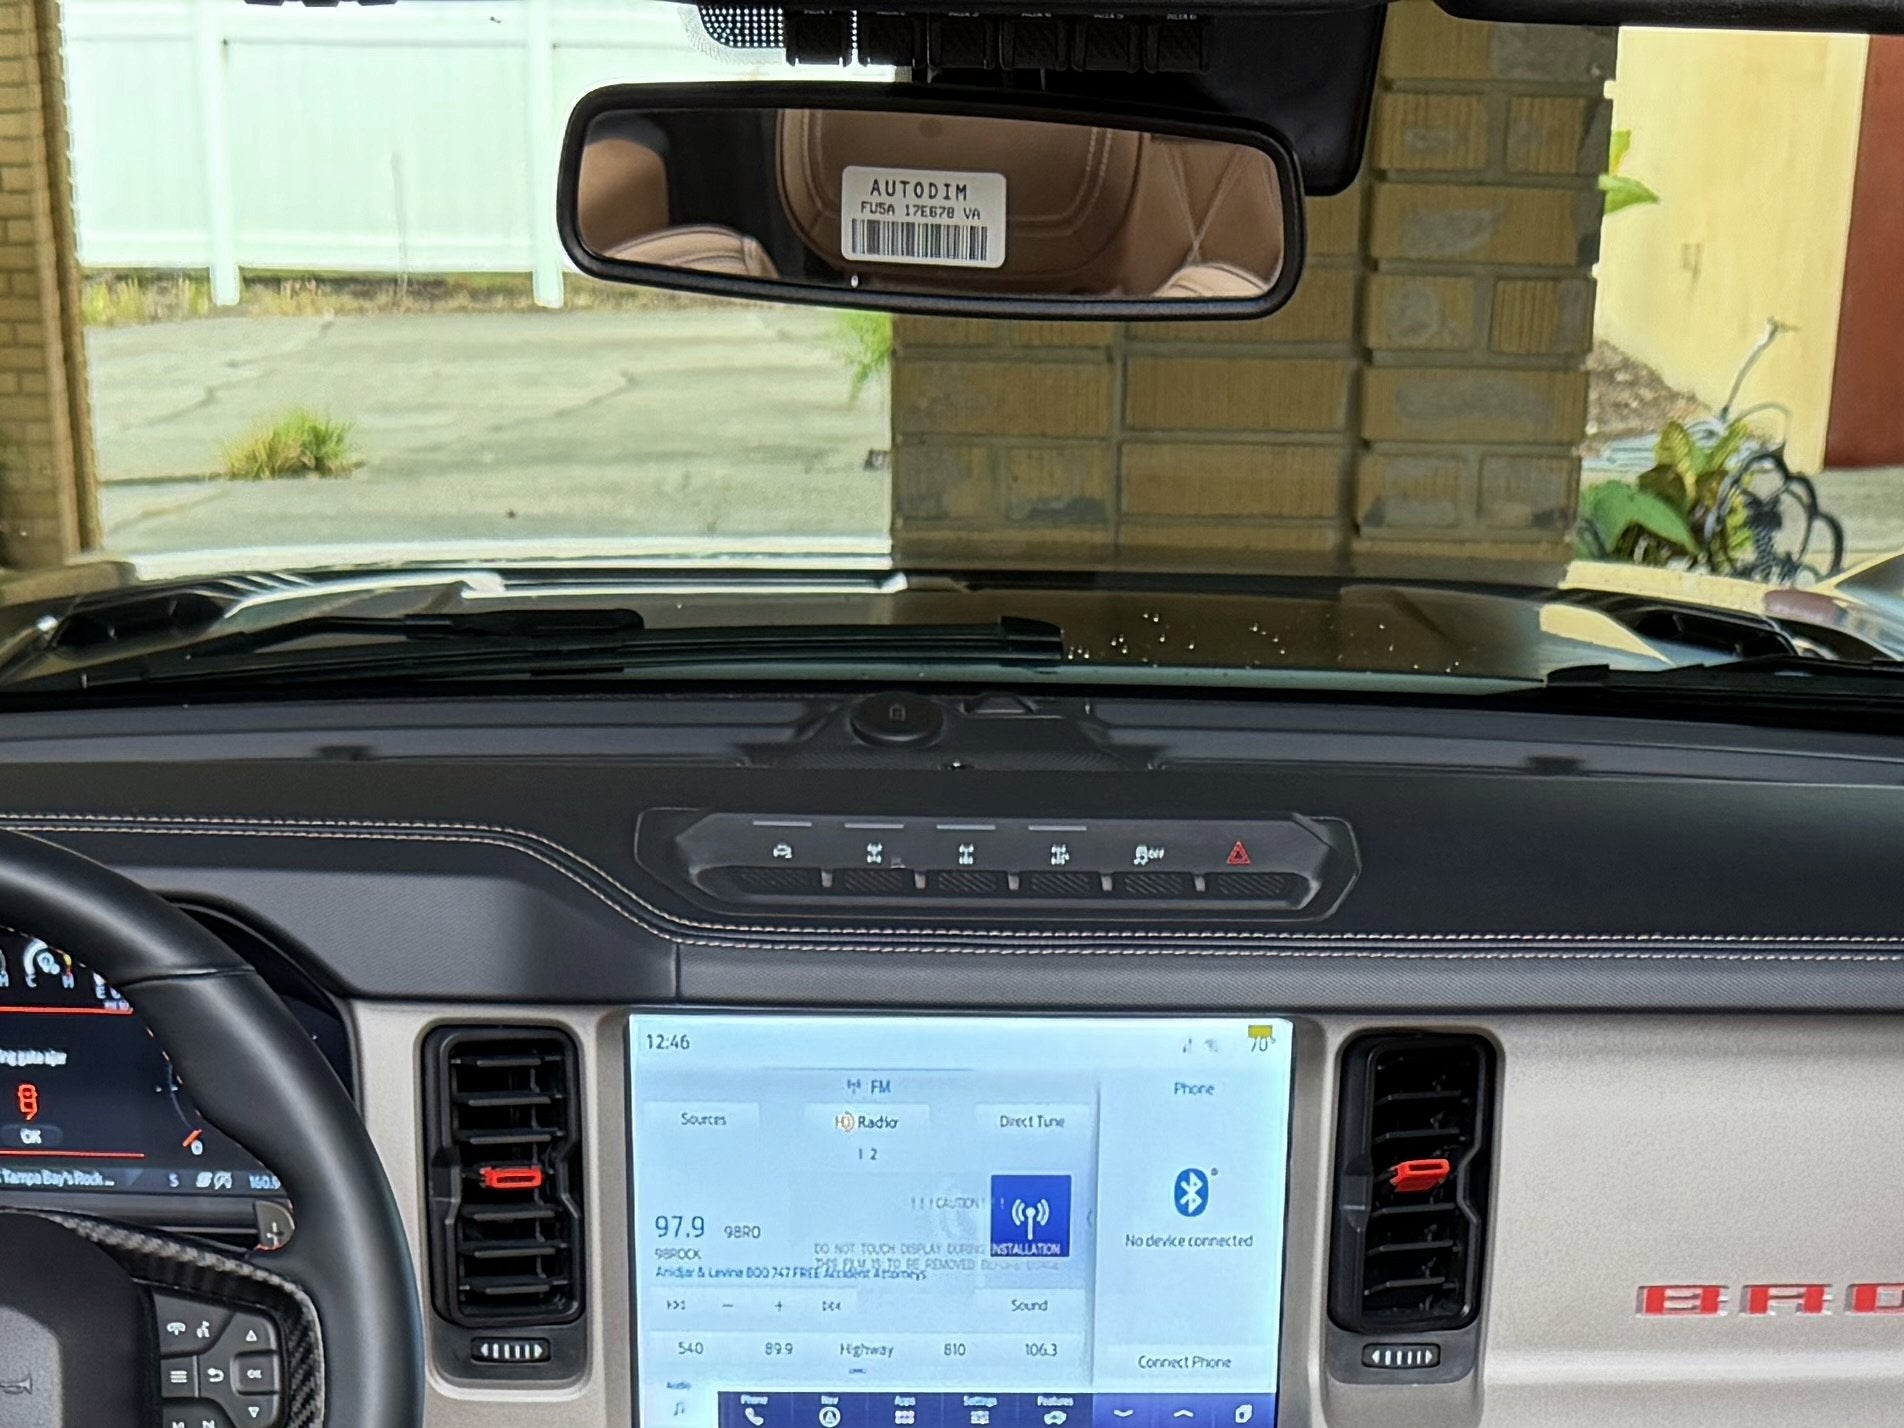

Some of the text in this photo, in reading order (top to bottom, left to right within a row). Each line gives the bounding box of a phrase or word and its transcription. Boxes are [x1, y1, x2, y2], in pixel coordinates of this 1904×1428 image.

[870, 178, 967, 202] AUTODIM
[860, 200, 895, 216] FU5A
[963, 206, 981, 220] VA
[646, 1032, 690, 1051] 12:46
[870, 1078, 891, 1094] FM
[1174, 1081, 1215, 1096] Phone
[681, 1111, 727, 1127] Sources
[858, 1114, 899, 1130] Radio
[1000, 1114, 1065, 1129] Direct Tune
[20, 1127, 42, 1145] OK
[654, 1215, 705, 1239] 97.9
[1125, 1233, 1253, 1248] No device connected
[992, 1242, 1061, 1256] INSTALLATION
[1011, 1298, 1048, 1312] Sound
[678, 1341, 704, 1355] 540
[1138, 1355, 1232, 1370] Connect Phone
